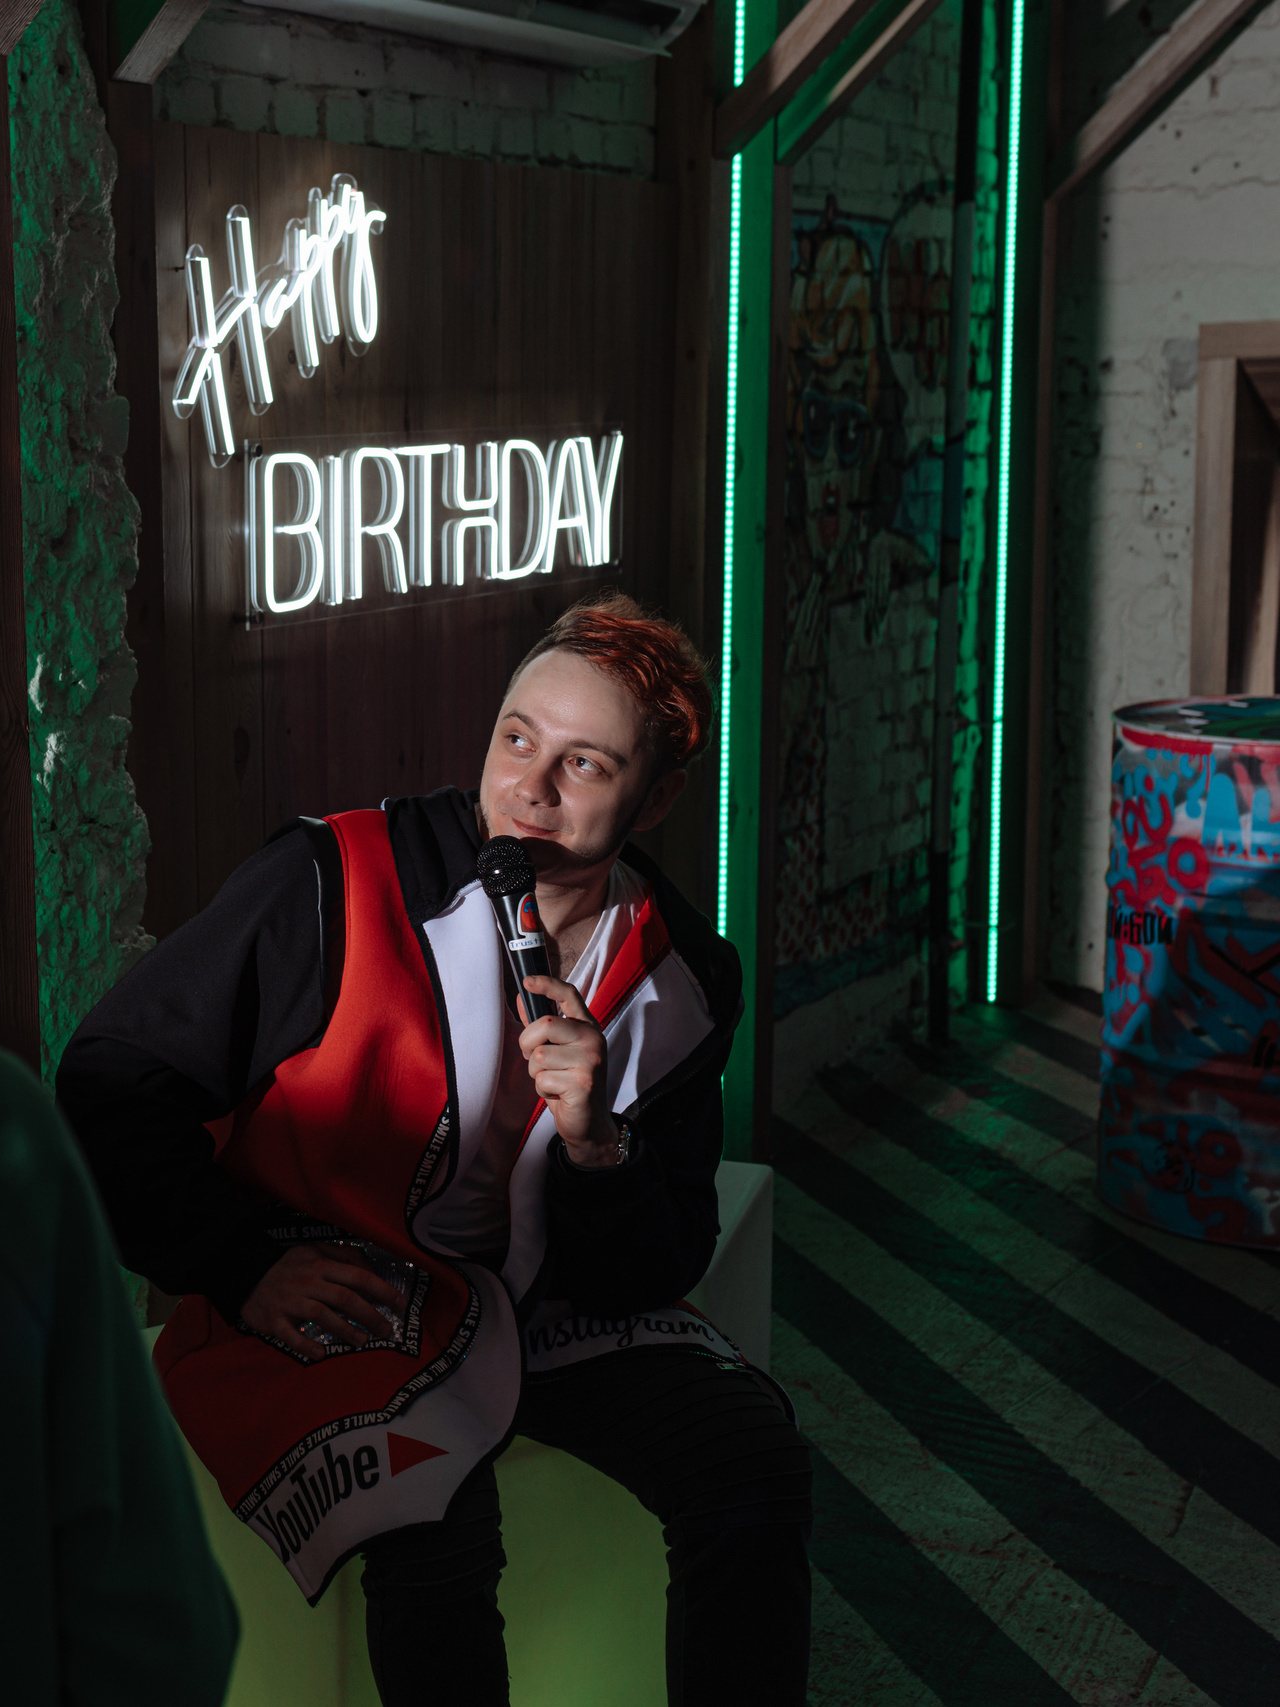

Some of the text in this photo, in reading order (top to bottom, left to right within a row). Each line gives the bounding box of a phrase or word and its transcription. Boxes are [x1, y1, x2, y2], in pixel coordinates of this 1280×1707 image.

[172, 178, 388, 460] Happy
[260, 432, 625, 613] BIRTHDAY
[255, 1442, 380, 1564] YouTube
